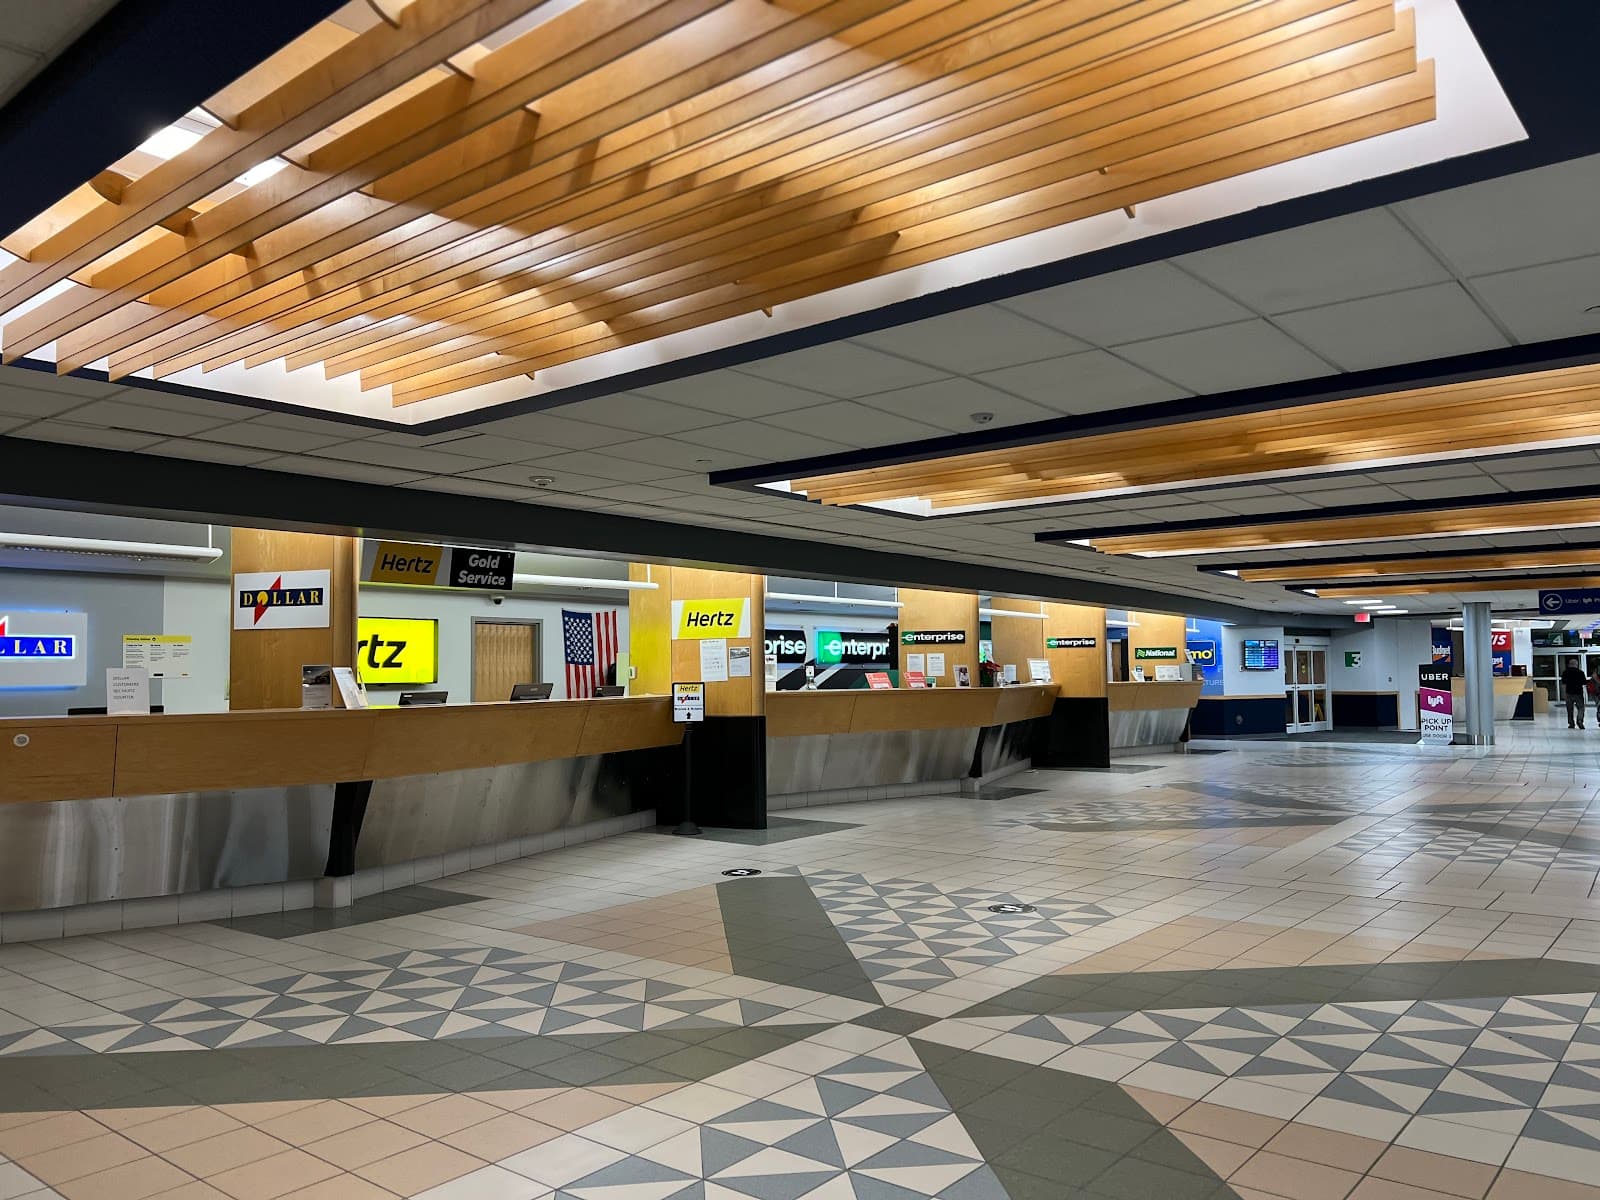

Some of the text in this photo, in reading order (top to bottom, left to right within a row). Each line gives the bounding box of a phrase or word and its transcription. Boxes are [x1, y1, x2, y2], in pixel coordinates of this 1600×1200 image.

[380, 553, 434, 573] Hertz
[468, 554, 501, 569] Gold
[457, 570, 506, 586] Service
[243, 590, 320, 606] DOLLAR
[687, 611, 735, 628] Hertz
[901, 632, 965, 643] enterprise
[1047, 638, 1095, 647] enterprise
[1552, 635, 1564, 646] 4
[1351, 653, 1361, 668] 3
[1421, 673, 1449, 681] UBER
[679, 684, 699, 693] Hertz
